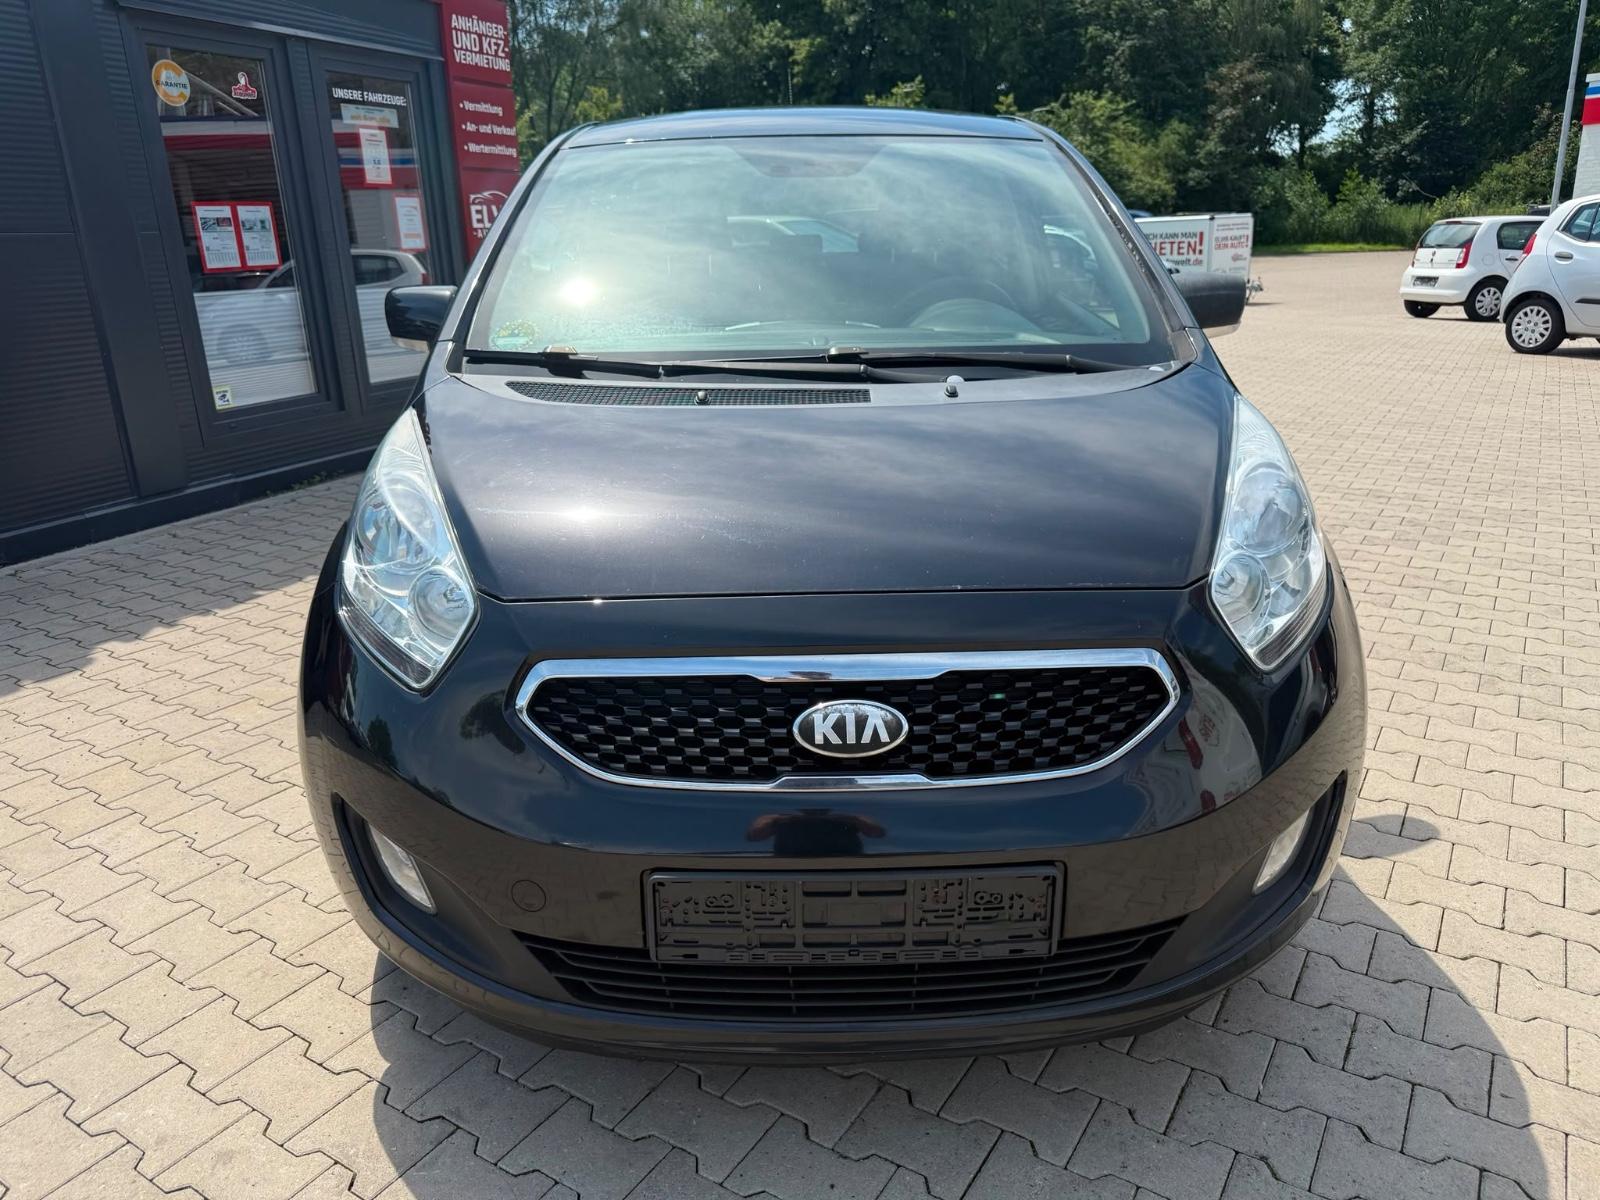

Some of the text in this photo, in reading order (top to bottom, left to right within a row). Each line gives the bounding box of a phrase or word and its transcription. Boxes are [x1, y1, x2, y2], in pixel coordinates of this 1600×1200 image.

[451, 14, 507, 39] ANHÄNGER-
[452, 29, 509, 57] UND KFZ-
[453, 48, 511, 72] VERMIETUNG
[332, 87, 407, 106] UNSERE FAHRZEUGE:
[463, 100, 503, 117] Vermittlung
[466, 122, 517, 136] An- und Verkauf
[468, 143, 517, 158] Wertermittlung
[1159, 231, 1179, 240] KANN
[1180, 231, 1197, 239] MAN
[812, 712, 891, 745] KIA
